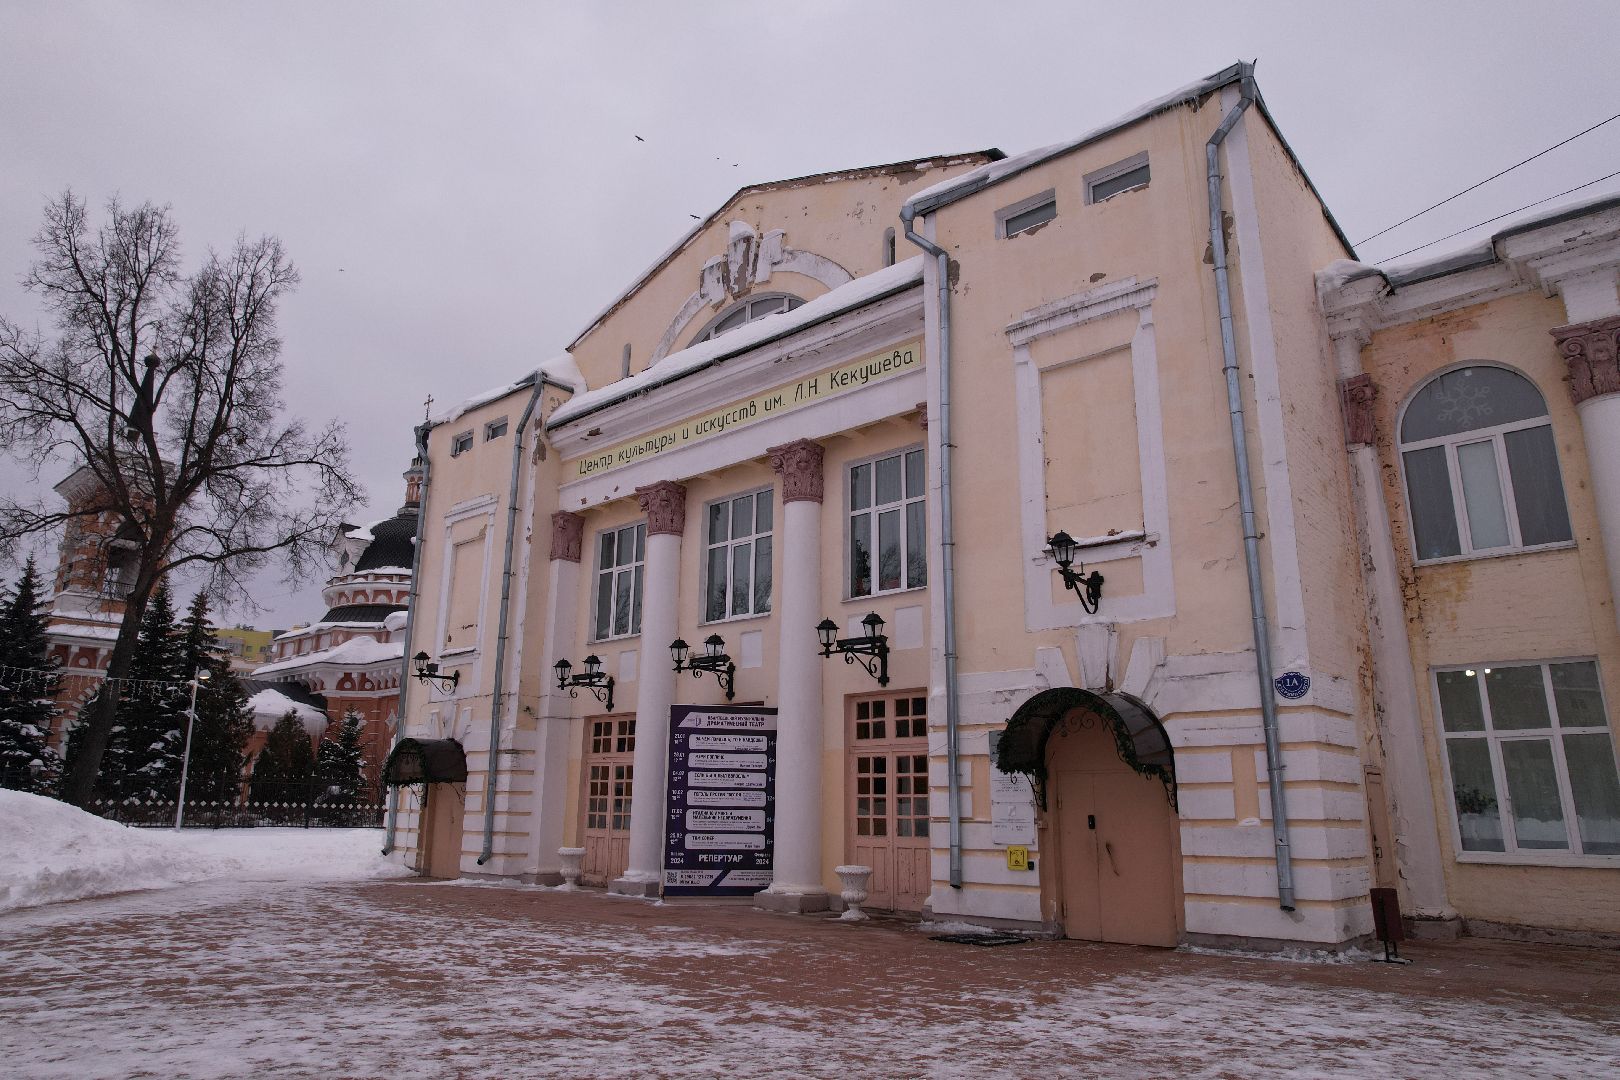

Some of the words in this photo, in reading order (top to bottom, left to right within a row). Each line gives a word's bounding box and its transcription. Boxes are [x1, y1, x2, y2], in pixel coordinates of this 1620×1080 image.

[579, 454, 613, 474] Центр
[618, 432, 676, 463] культуры
[682, 428, 689, 440] и
[695, 401, 757, 432] искусств
[764, 395, 786, 411] им.
[794, 378, 821, 402] Л.Н.
[830, 350, 914, 389] Кекушева
[1286, 678, 1298, 686] 1А
[698, 854, 743, 863] РЕПЕРТУАР
[755, 858, 770, 866] 2024
